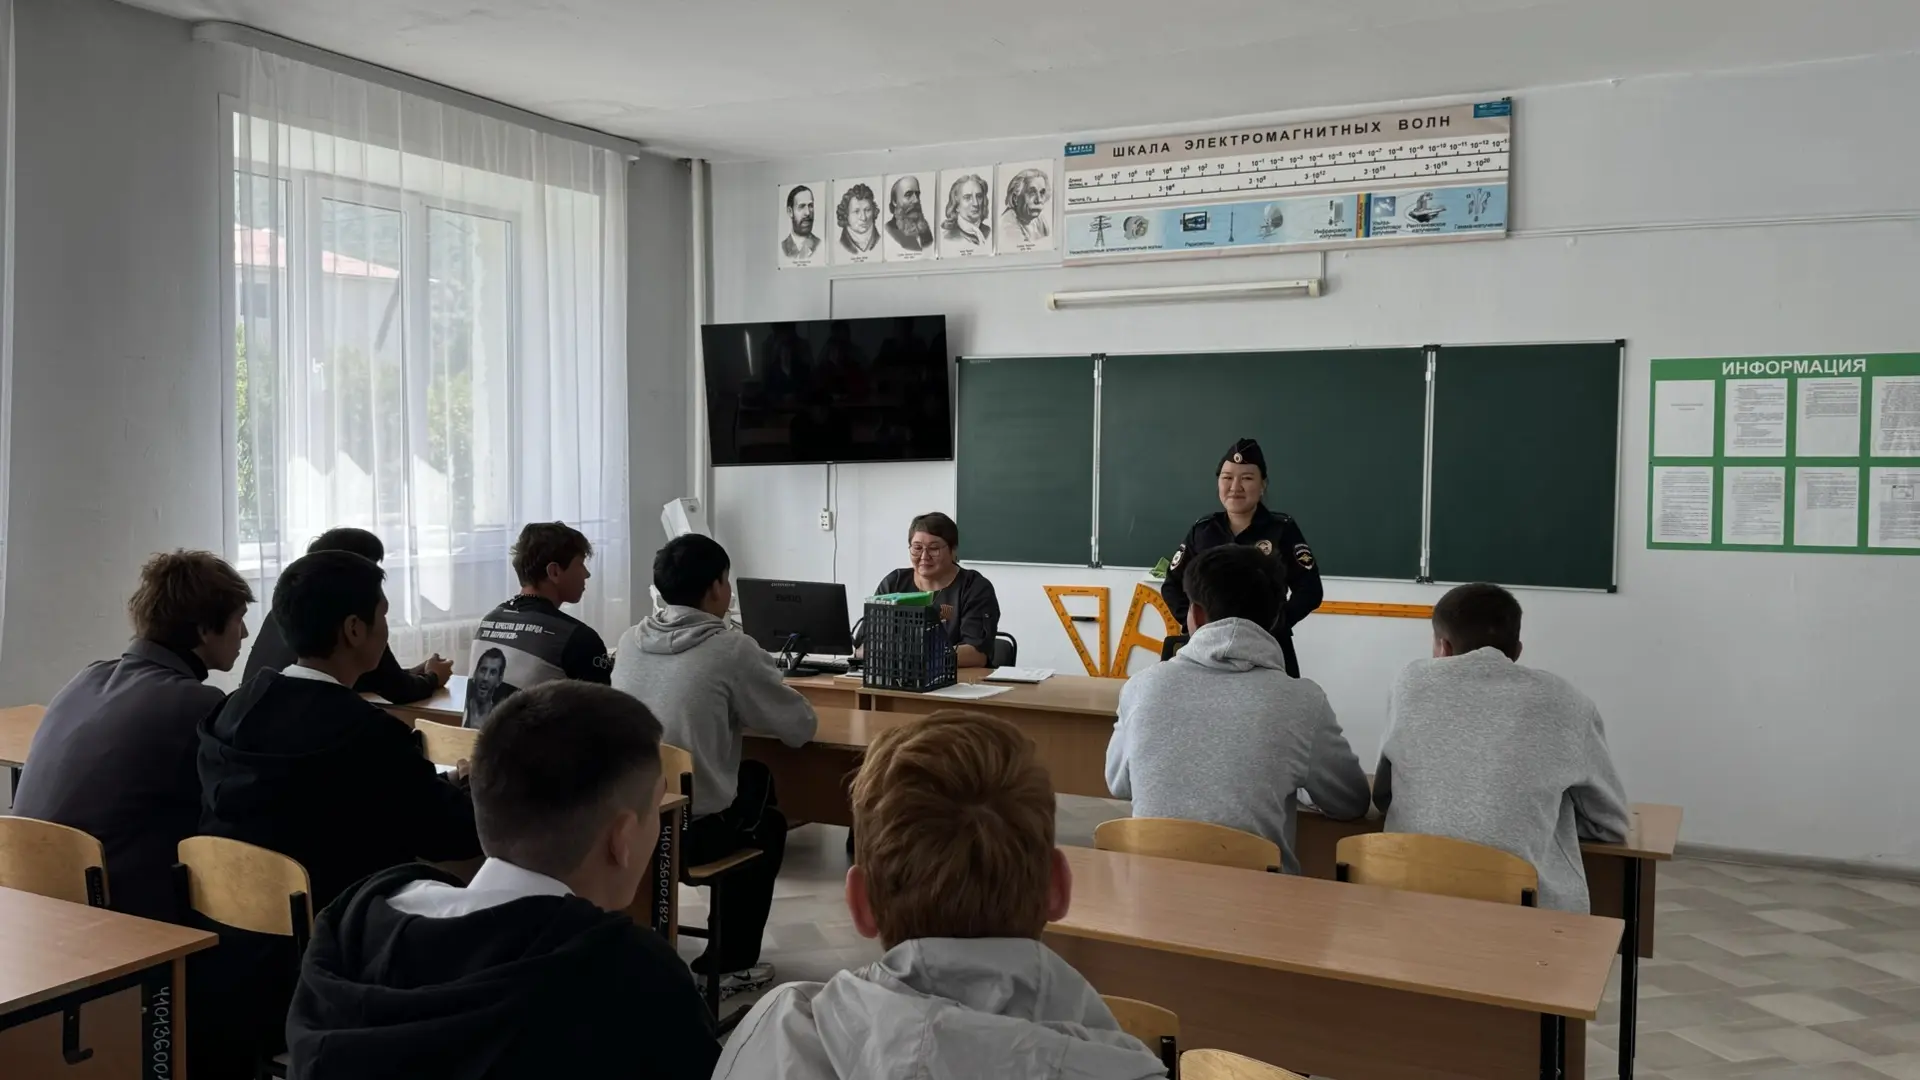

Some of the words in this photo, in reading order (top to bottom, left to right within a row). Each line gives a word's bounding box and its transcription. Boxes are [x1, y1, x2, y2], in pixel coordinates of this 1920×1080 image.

[1113, 142, 1170, 157] ШКАЛА
[1185, 121, 1381, 150] ЭЛЕКТРОМАГНИТНЫХ
[1399, 116, 1450, 131] ВОЛН
[1722, 358, 1866, 375] ИНФОРМАЦИЯ
[660, 826, 672, 924] 41013600182
